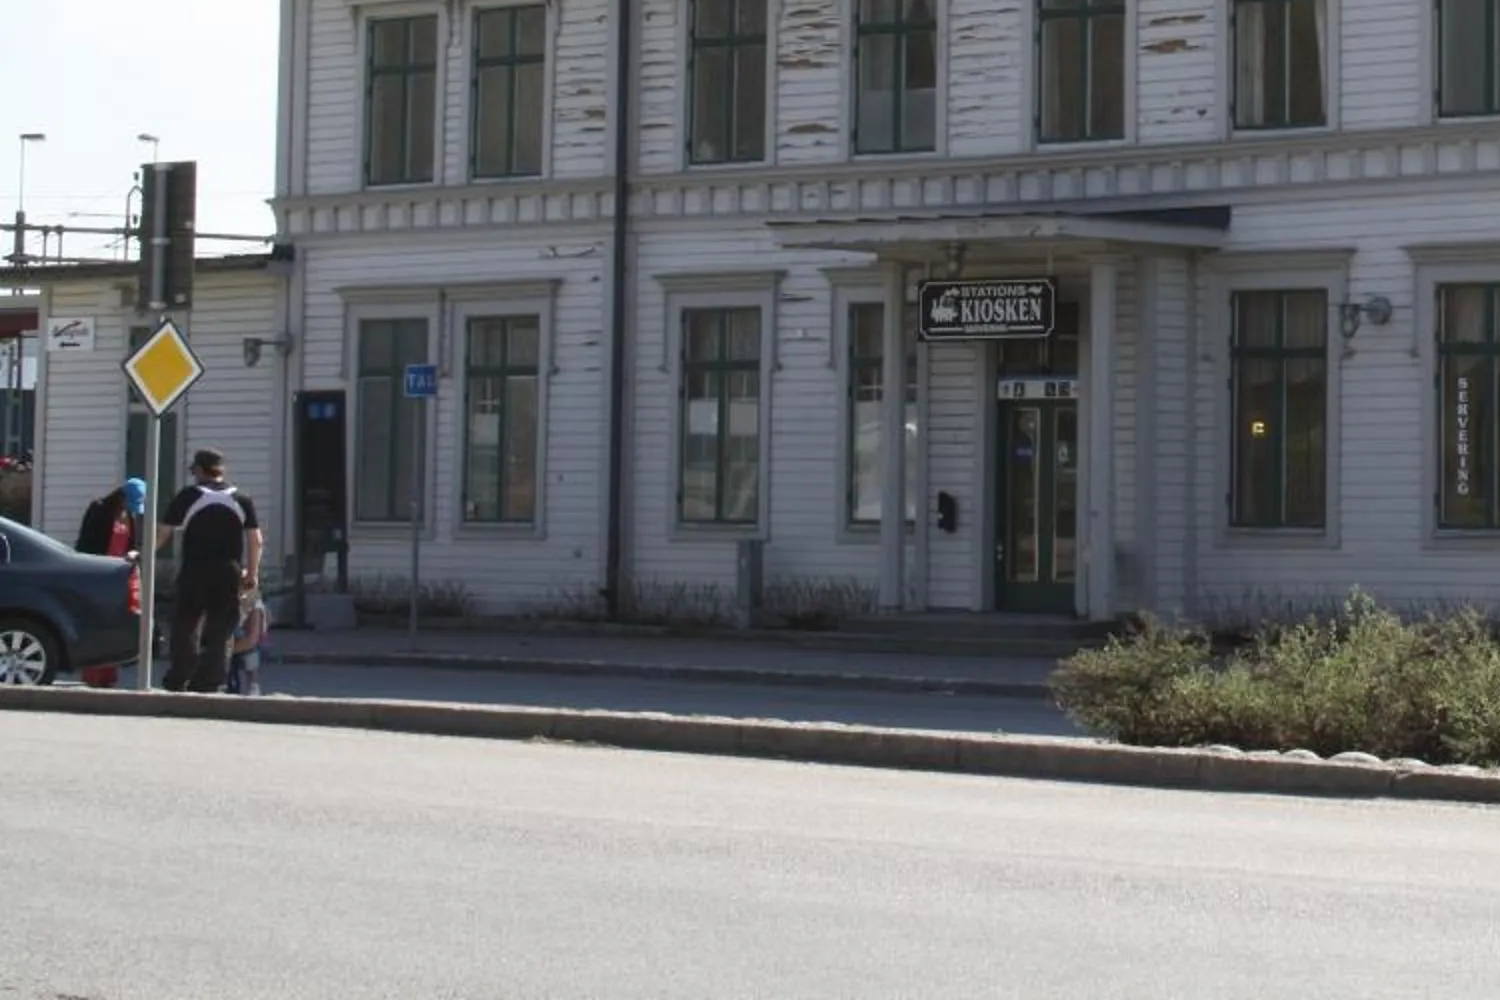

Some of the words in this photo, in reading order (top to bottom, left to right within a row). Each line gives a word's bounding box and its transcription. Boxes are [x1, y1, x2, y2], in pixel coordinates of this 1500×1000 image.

[960, 286, 1026, 297] STATIONS
[961, 298, 1042, 323] KIOSKEN
[1457, 377, 1470, 496] SERVERING
